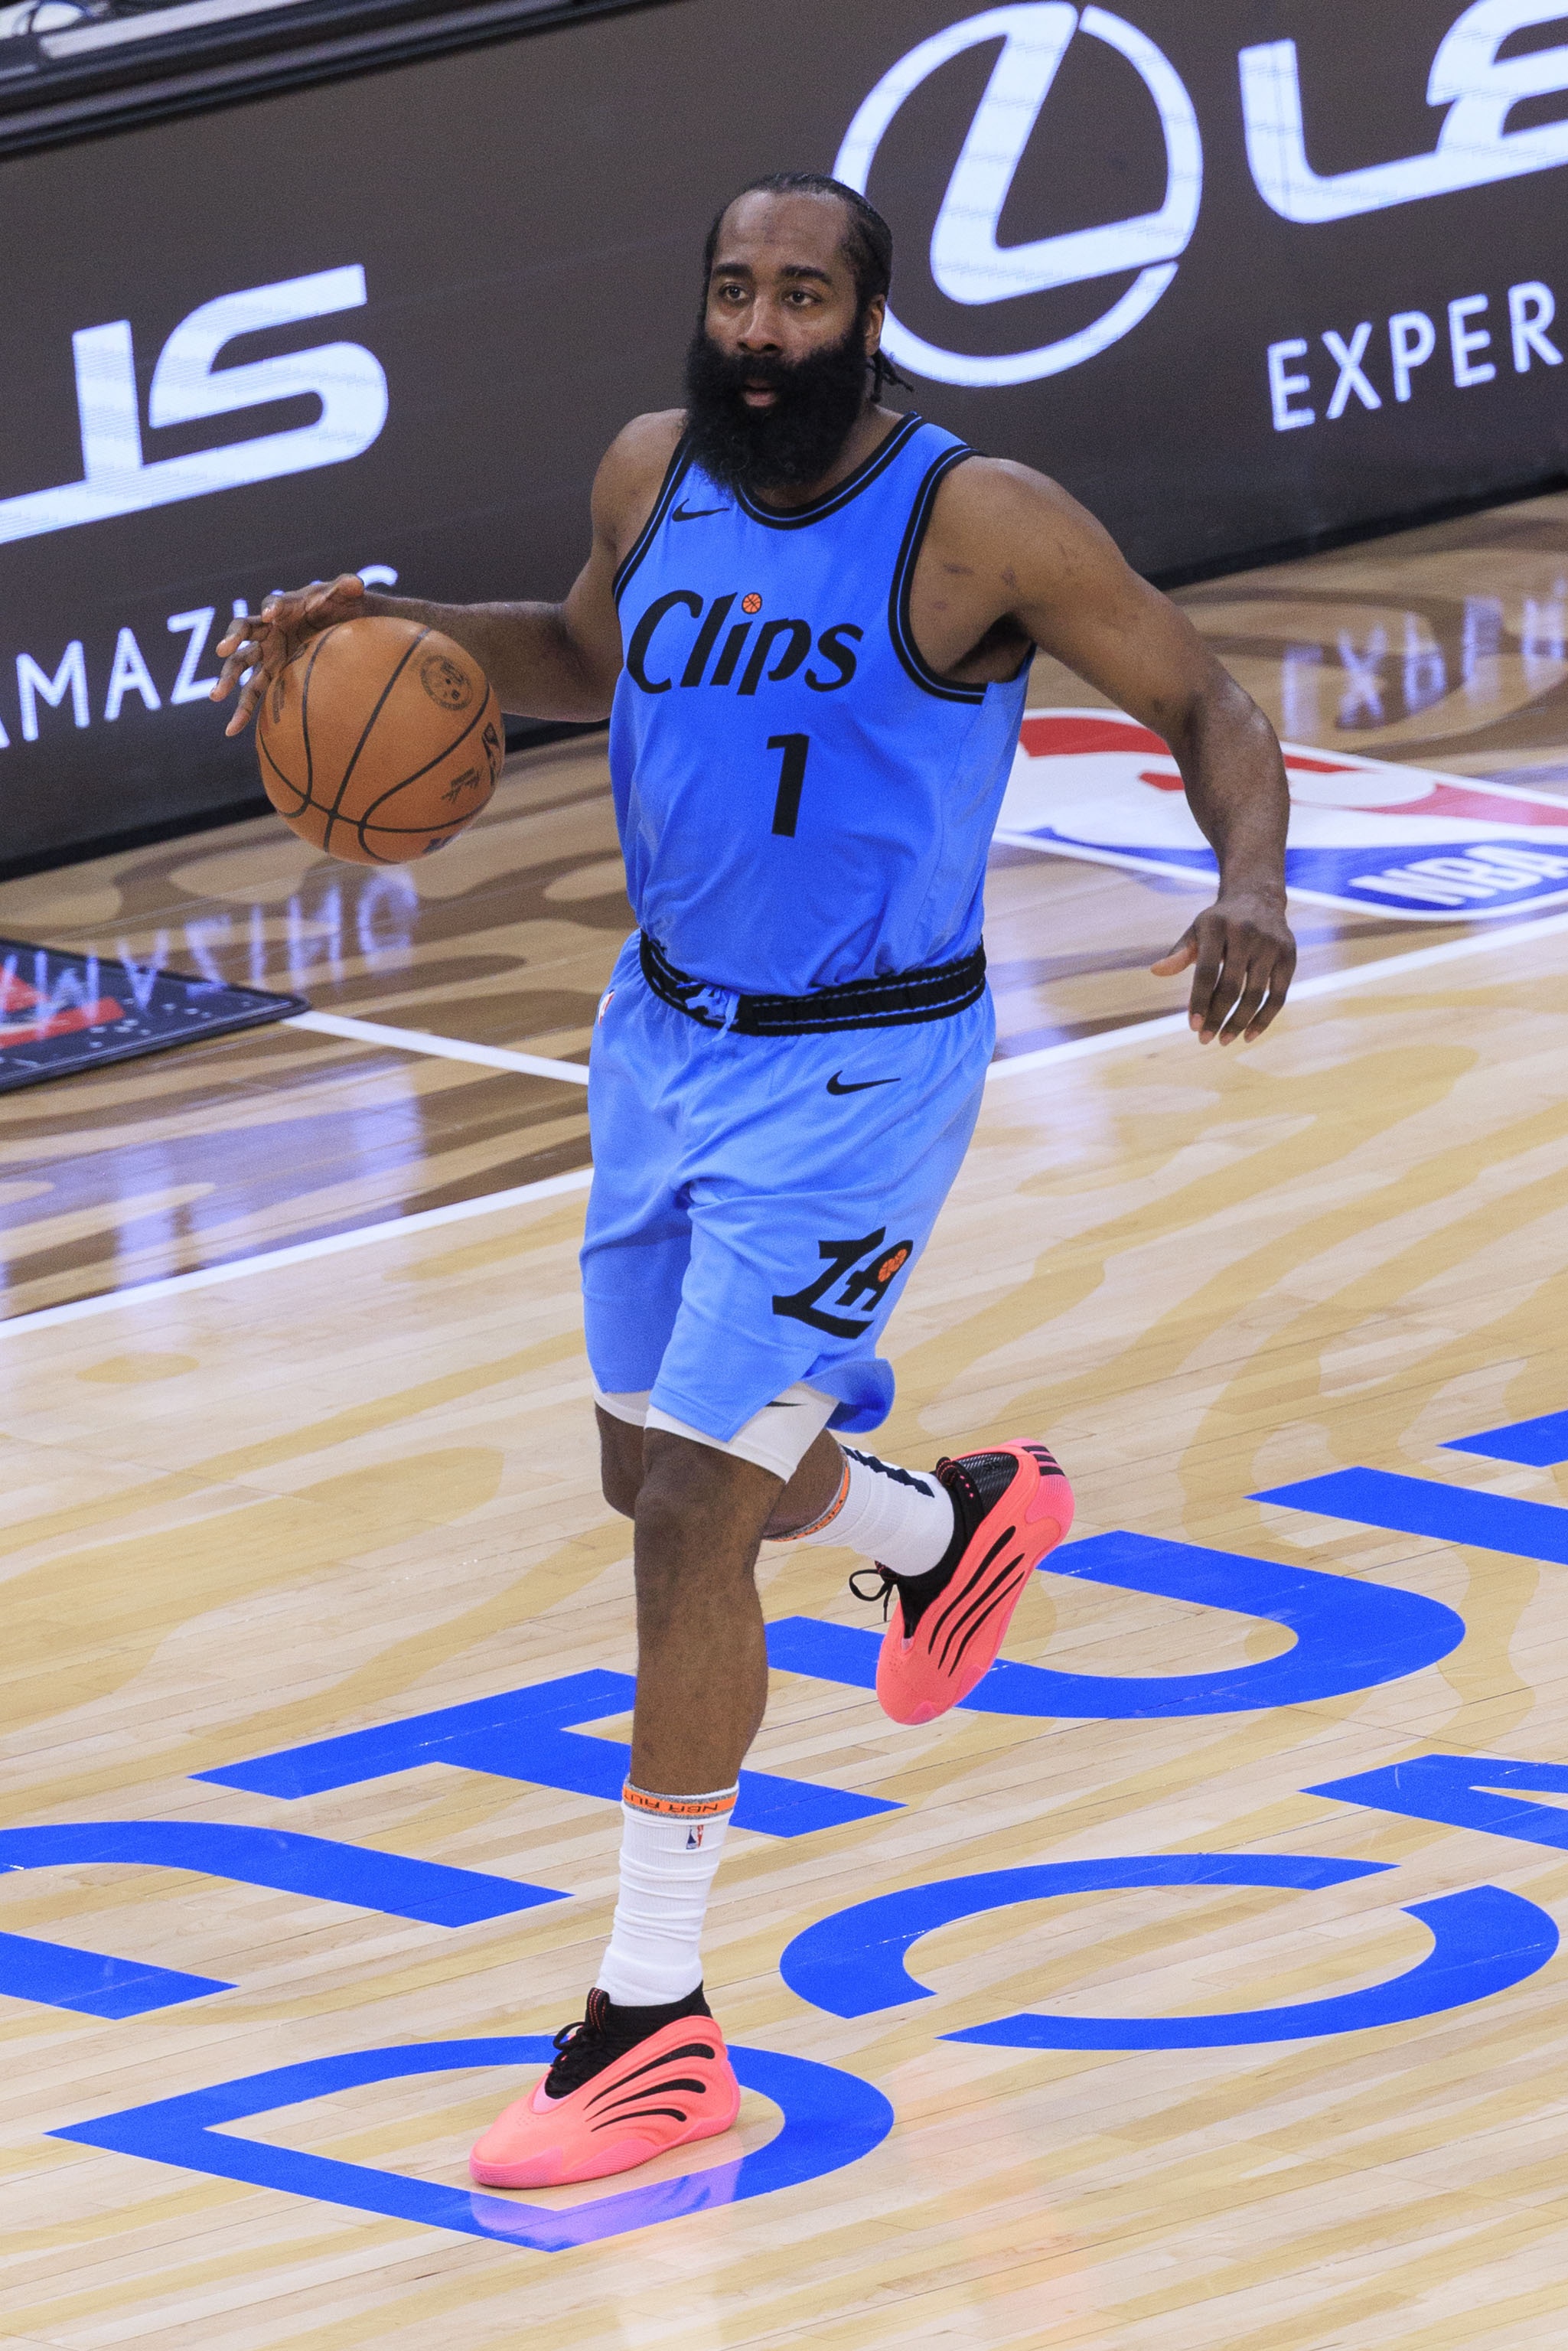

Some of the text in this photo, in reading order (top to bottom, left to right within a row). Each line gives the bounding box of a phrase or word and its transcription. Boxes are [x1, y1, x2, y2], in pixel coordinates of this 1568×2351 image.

[1267, 281, 1563, 432] EXPER
[627, 590, 865, 696] Clips
[767, 732, 810, 838] 1
[1348, 844, 1568, 906] NBA
[669, 1802, 718, 1814] NBA
